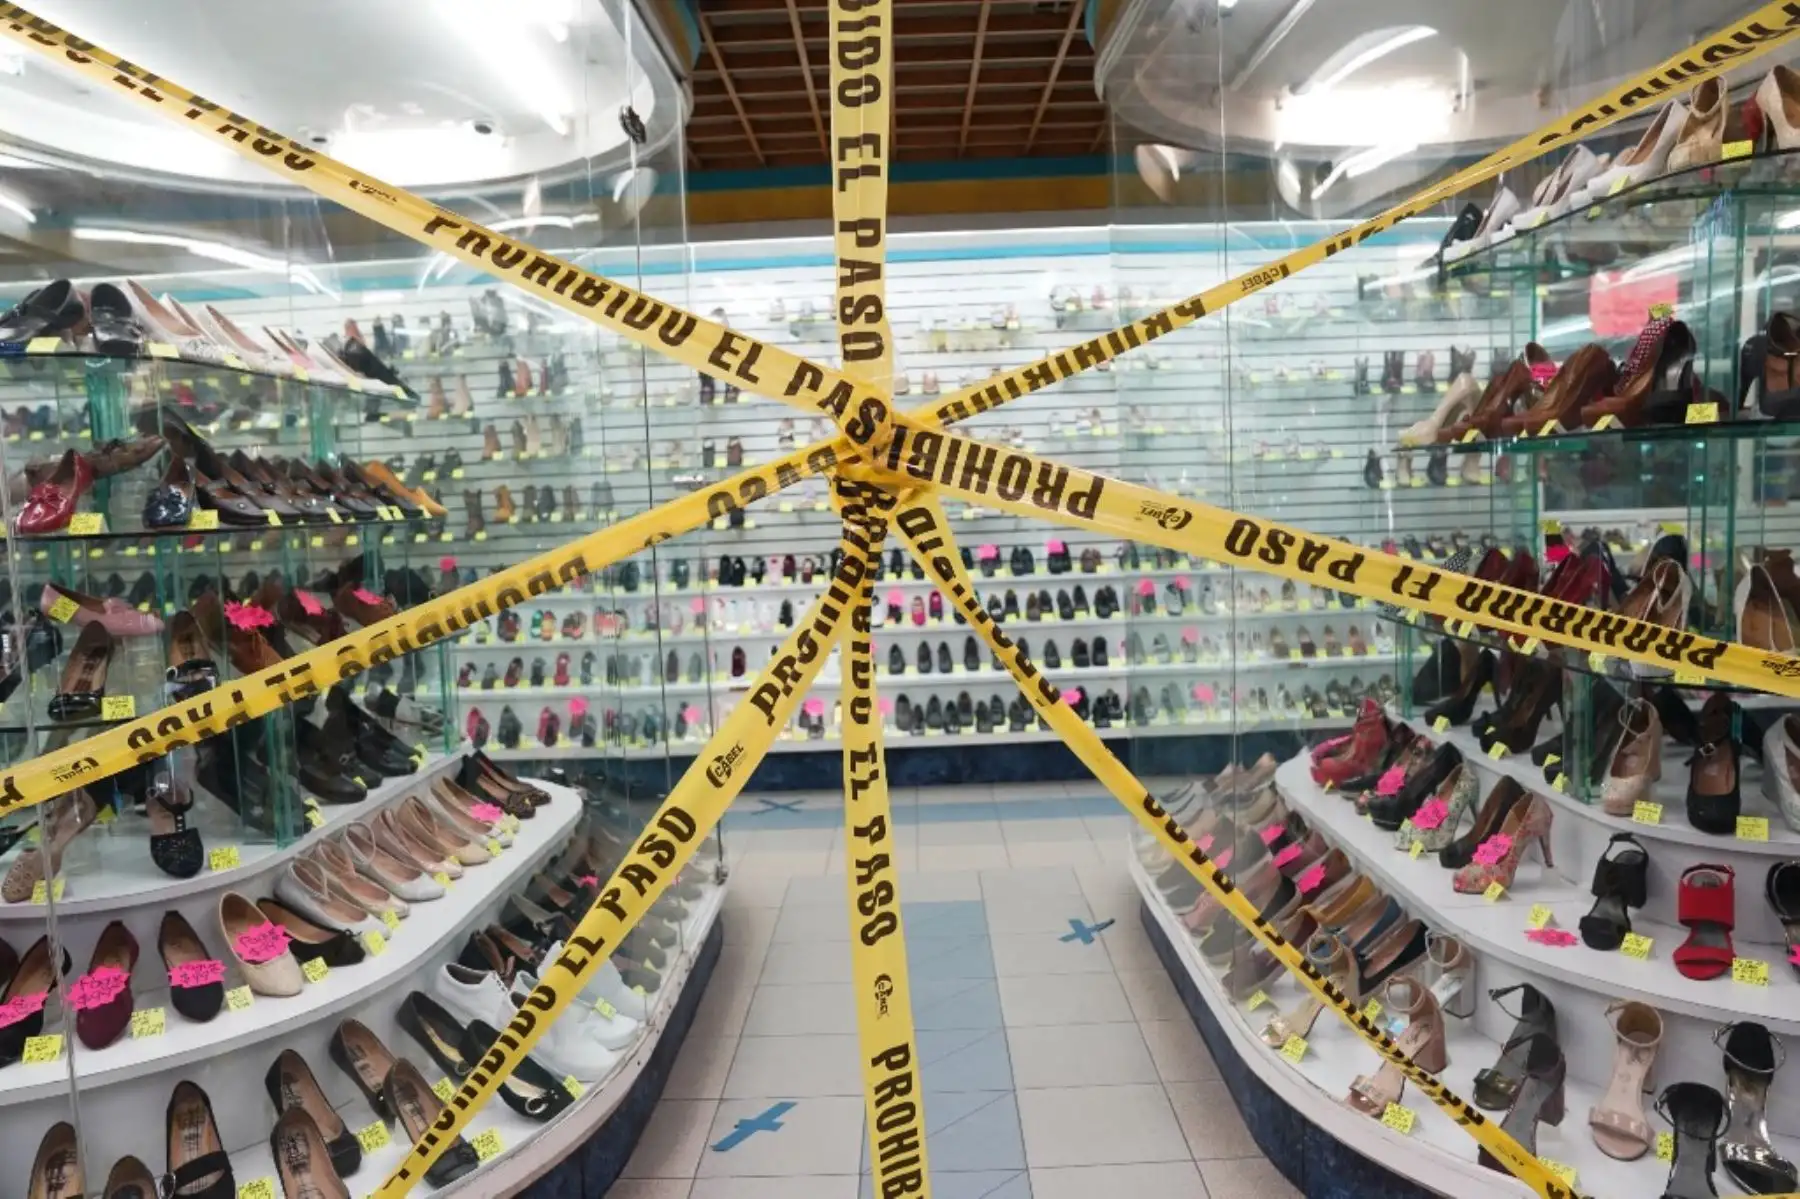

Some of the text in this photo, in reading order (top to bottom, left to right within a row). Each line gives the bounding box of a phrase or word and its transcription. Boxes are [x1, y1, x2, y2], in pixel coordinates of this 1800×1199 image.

[838, 133, 881, 193] EL
[839, 217, 885, 362] PASO
[708, 331, 763, 384] EL
[784, 361, 888, 448] PAS
[1225, 519, 1365, 584] PASO
[599, 807, 697, 922] PASO
[854, 815, 897, 946] PASO
[872, 1043, 924, 1199] PROHIB
